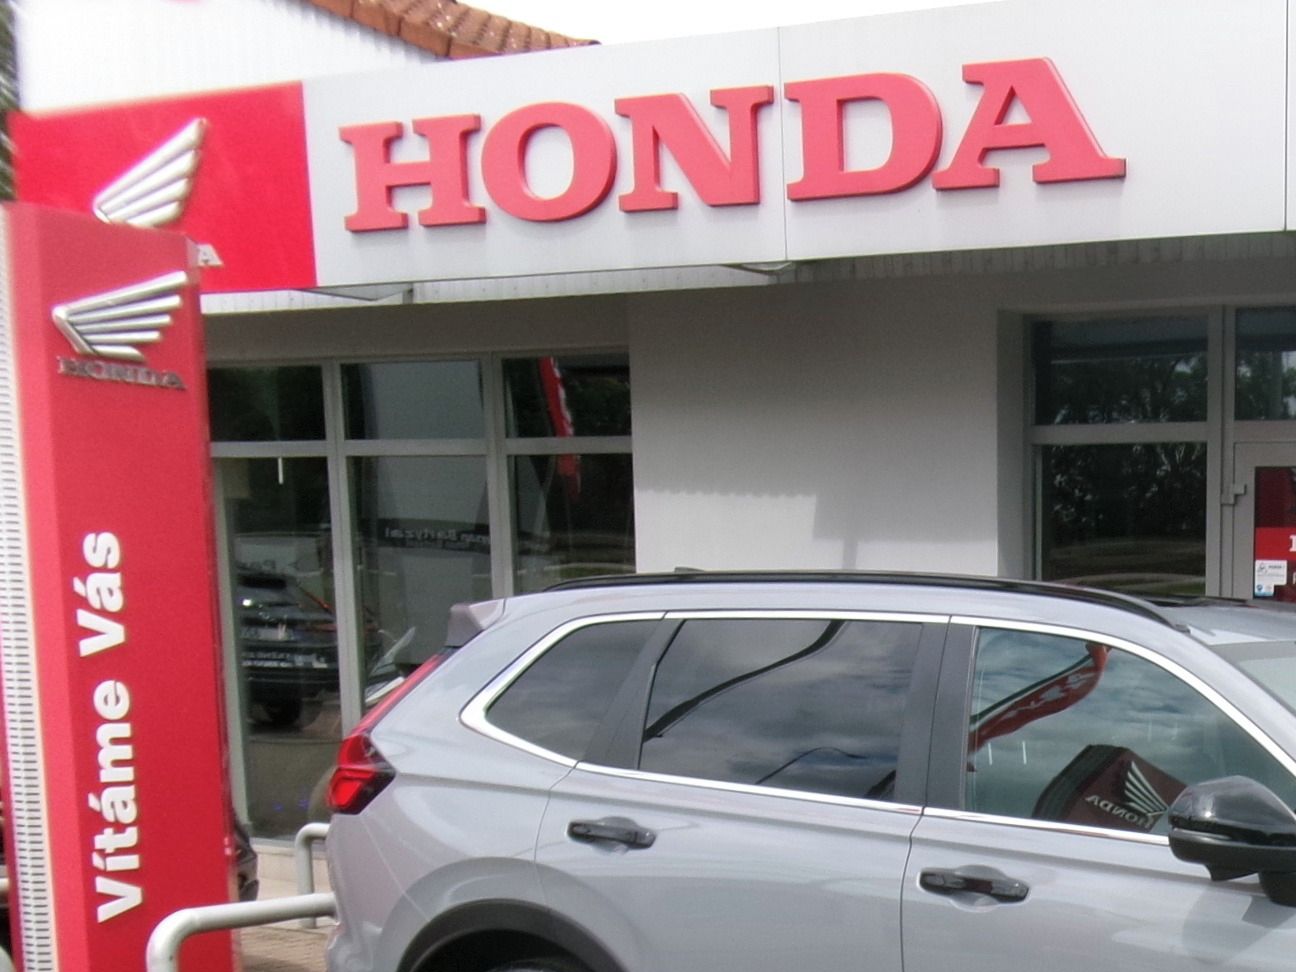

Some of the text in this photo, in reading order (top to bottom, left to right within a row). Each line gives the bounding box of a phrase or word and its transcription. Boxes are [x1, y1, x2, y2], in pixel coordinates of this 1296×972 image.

[338, 56, 1126, 233] HONDA
[56, 356, 187, 390] HONDA
[73, 532, 143, 923] Vítáme Vás
